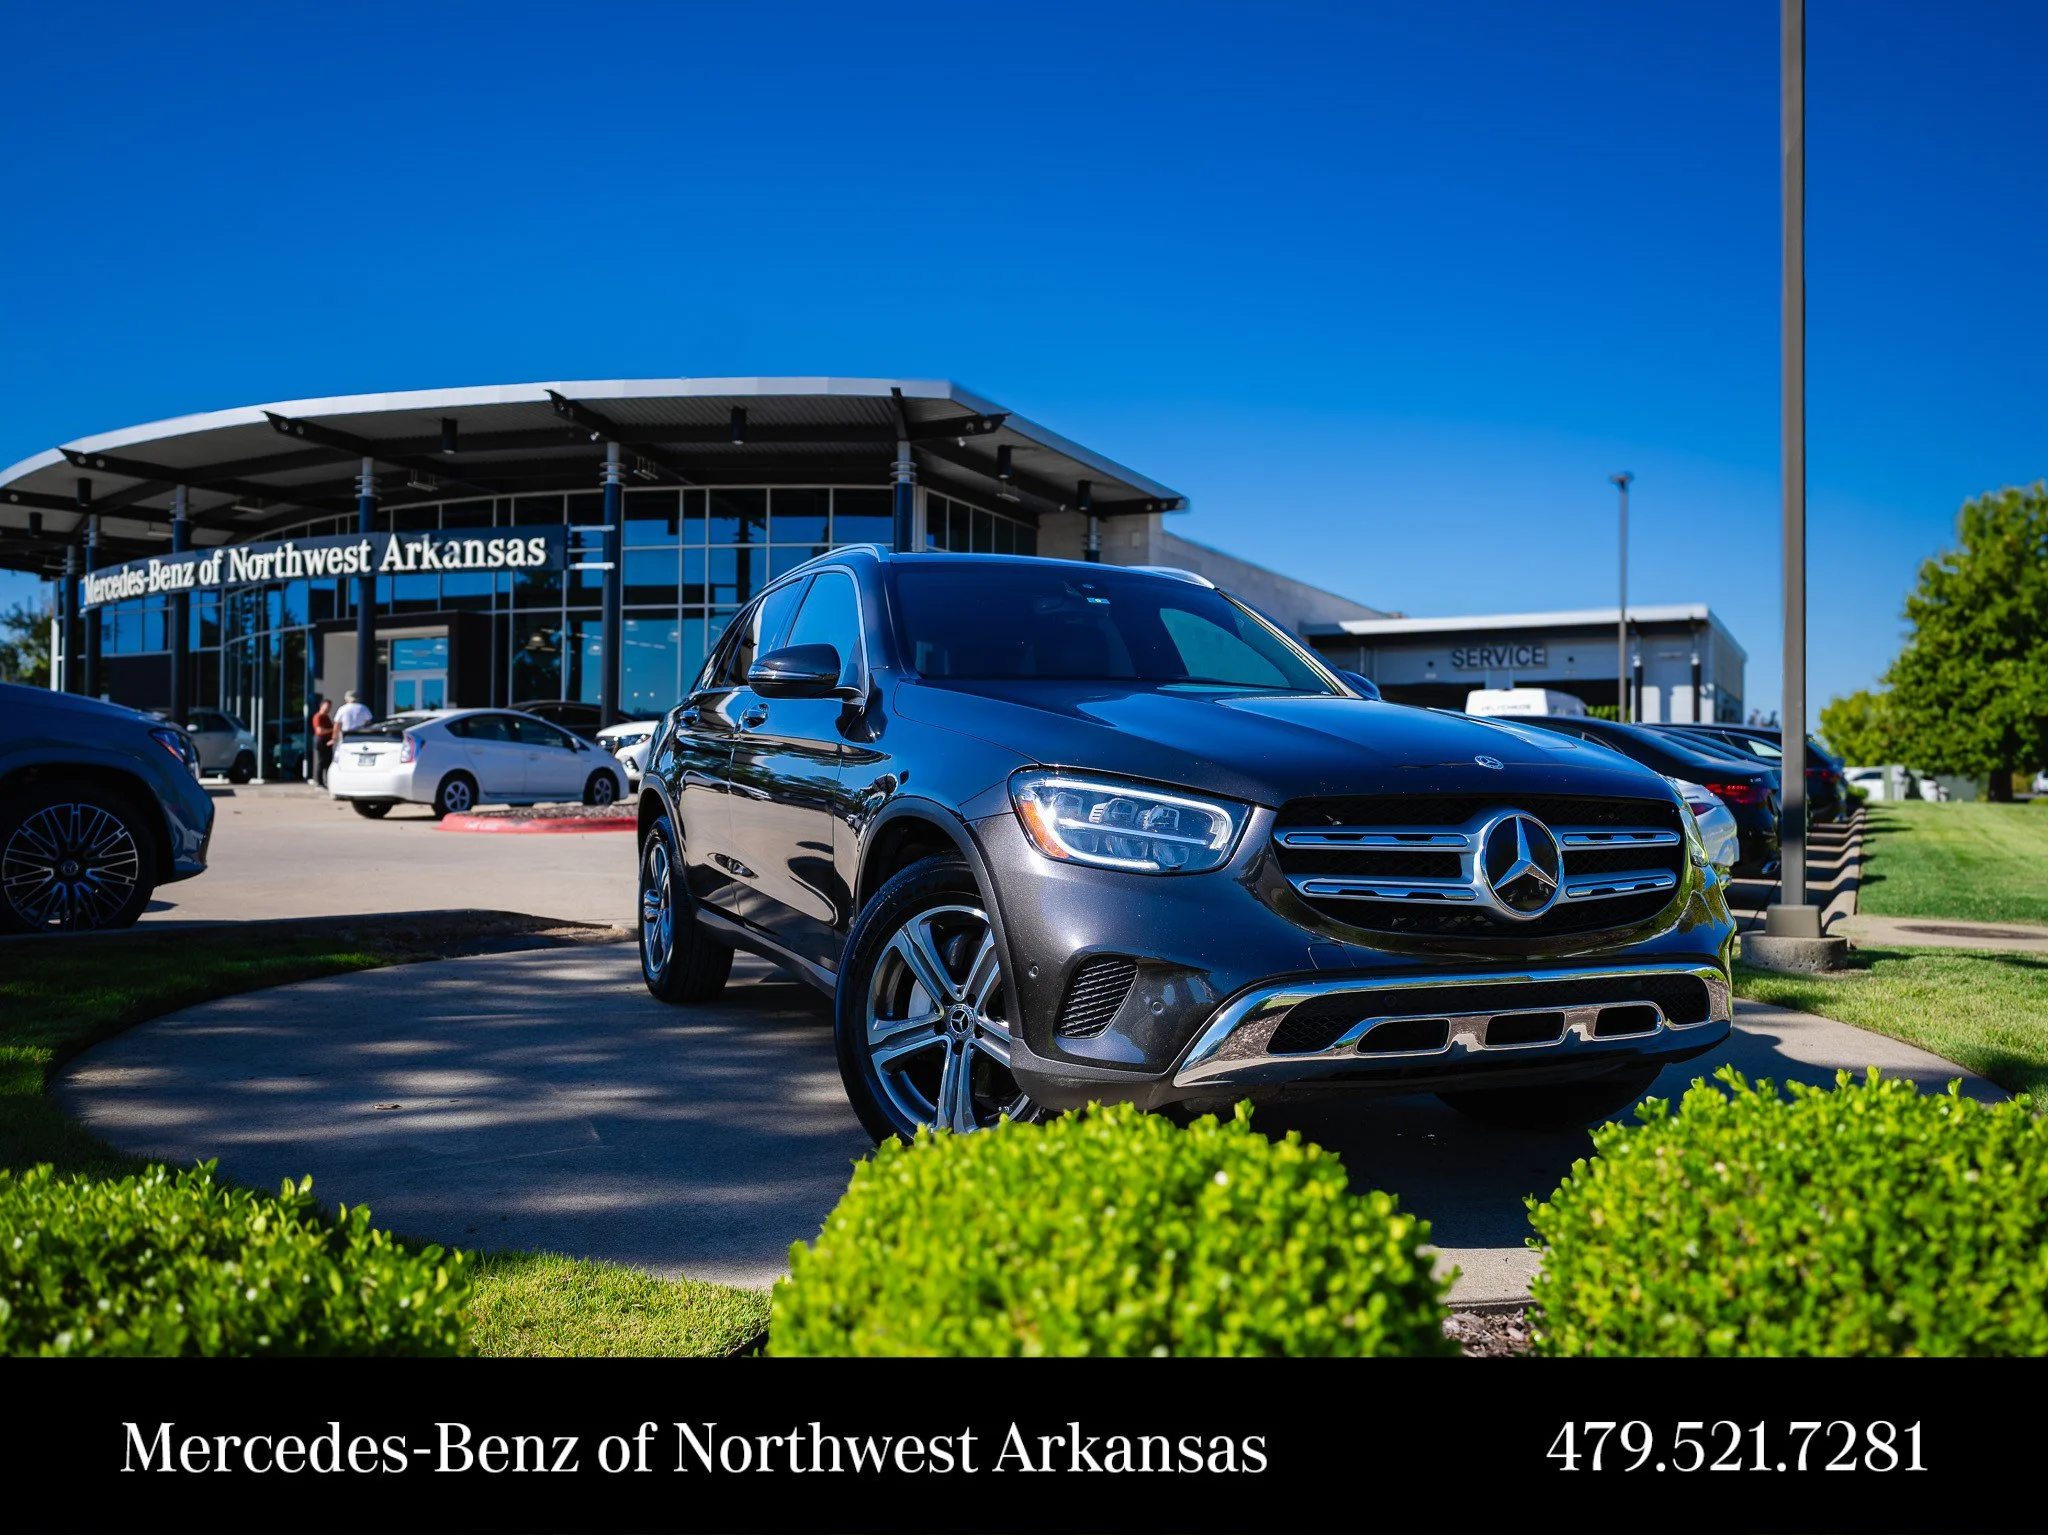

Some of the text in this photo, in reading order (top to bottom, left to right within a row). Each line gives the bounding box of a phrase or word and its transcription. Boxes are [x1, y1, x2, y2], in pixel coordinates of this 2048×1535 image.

[83, 533, 547, 606] Mercedes-Benz of Northwest Arkansas
[1452, 645, 1546, 669] SERVICE
